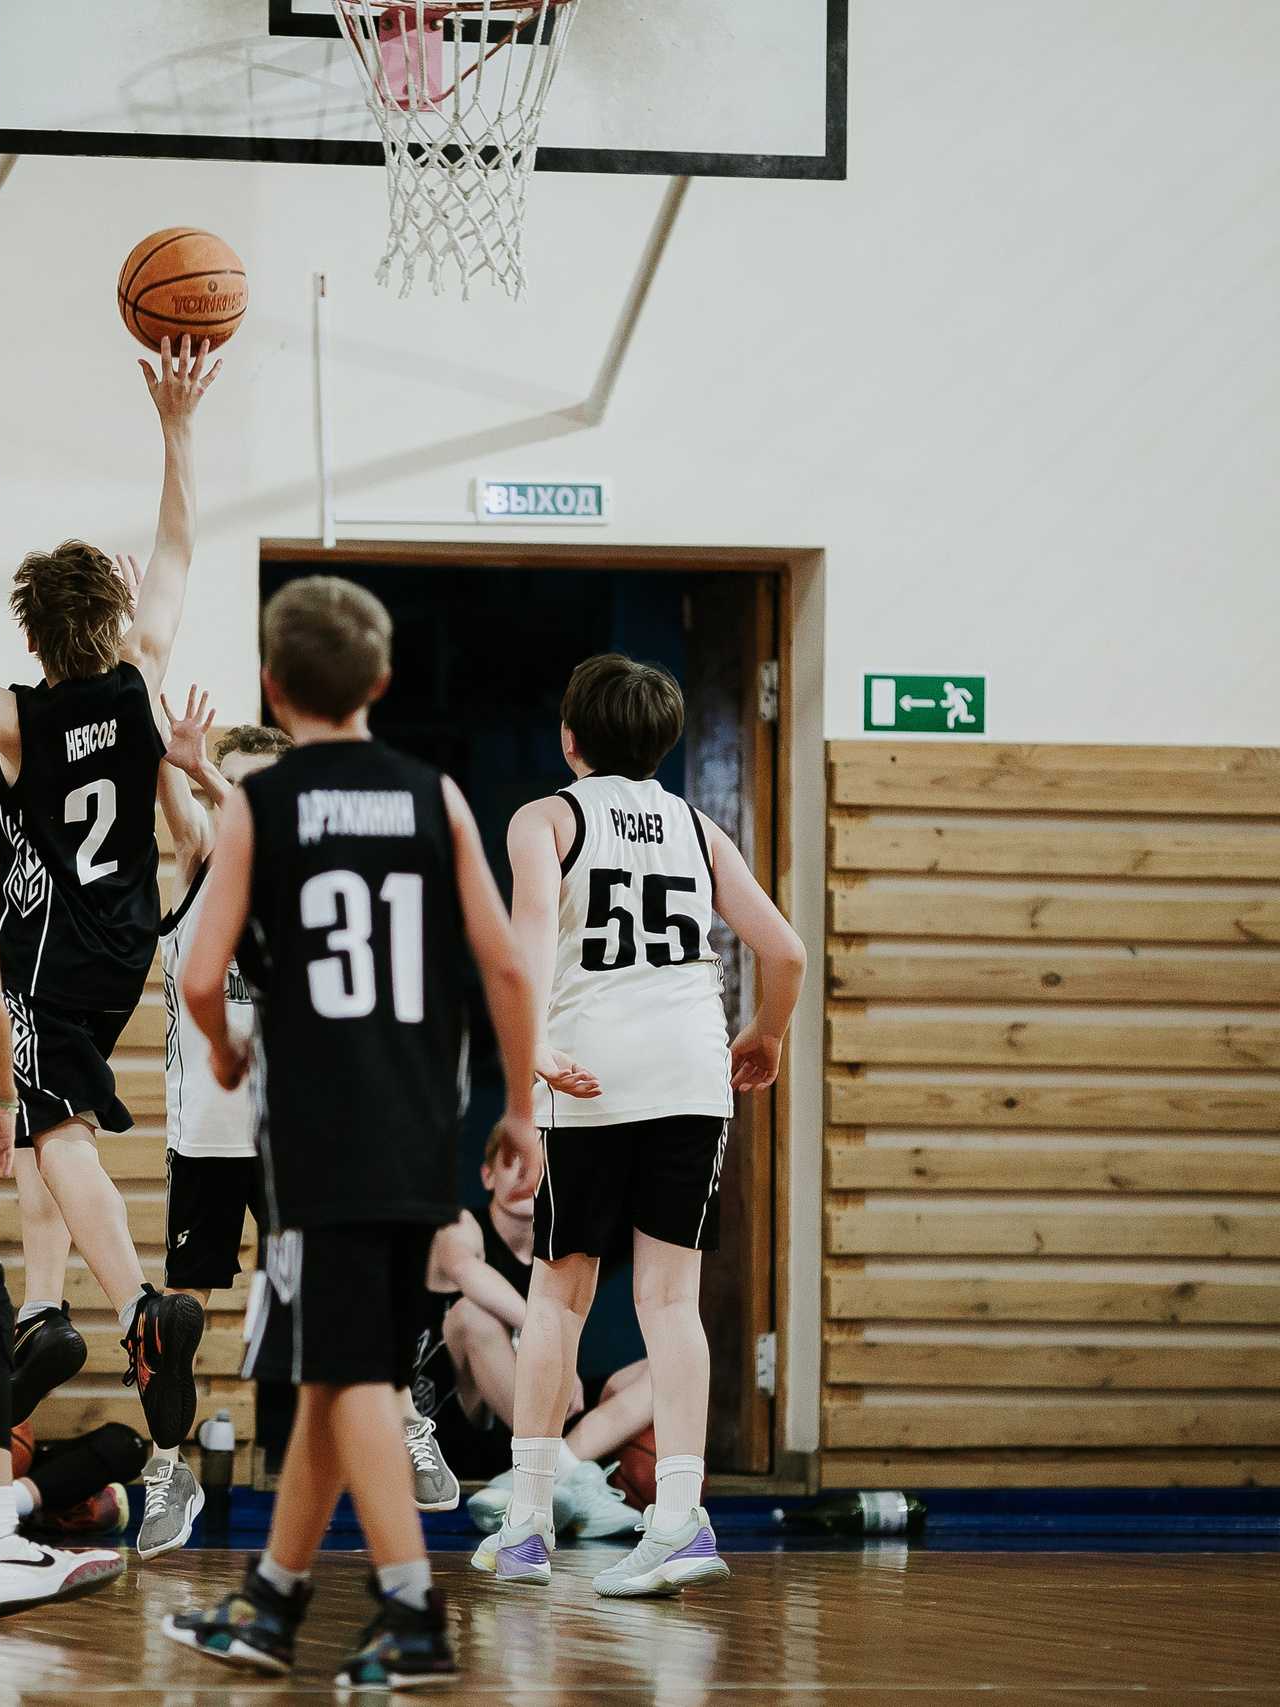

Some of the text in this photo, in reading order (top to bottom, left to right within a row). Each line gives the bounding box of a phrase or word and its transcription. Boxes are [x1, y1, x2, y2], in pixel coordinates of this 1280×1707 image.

[488, 485, 598, 514] ВЫХОД
[65, 719, 117, 762] НЕЯСОВ
[64, 779, 118, 886] 2
[300, 869, 424, 1023] 31
[580, 868, 701, 971] 55
